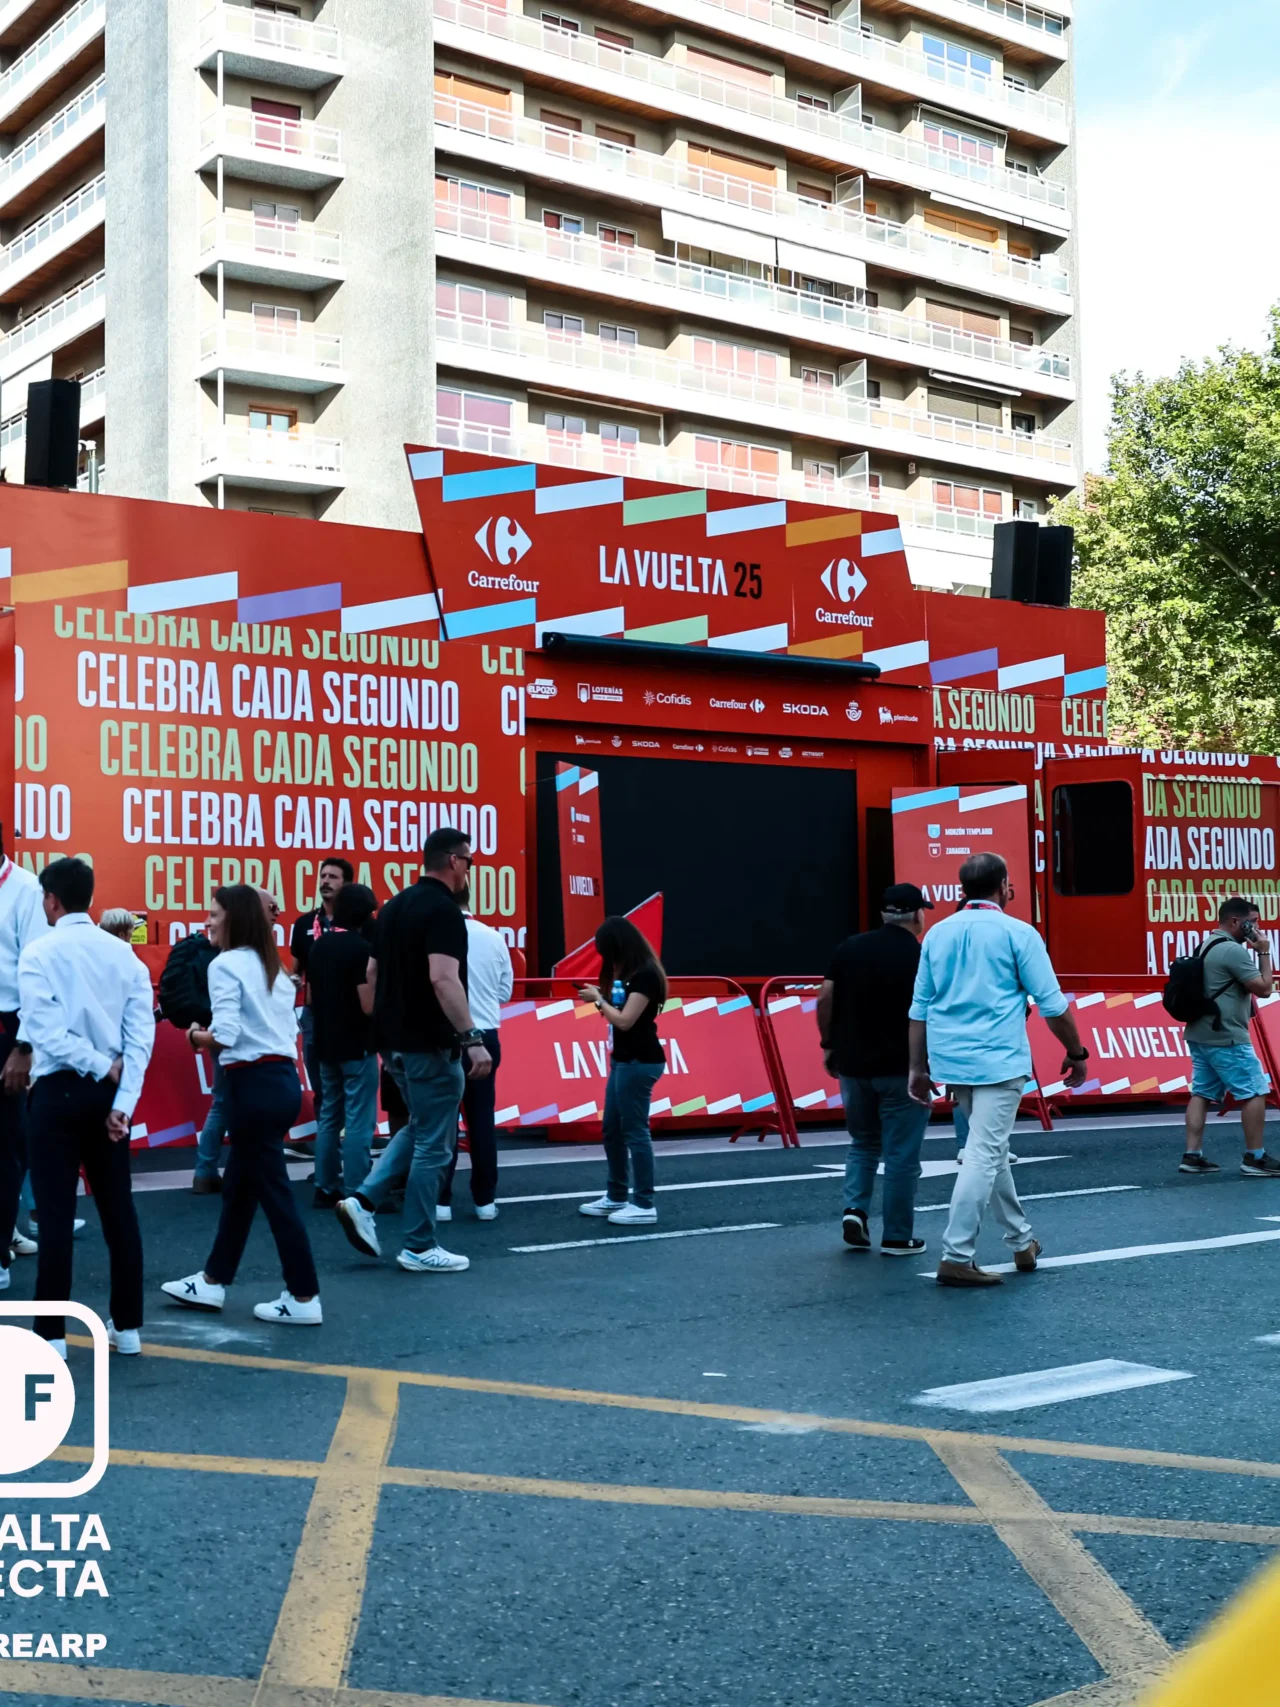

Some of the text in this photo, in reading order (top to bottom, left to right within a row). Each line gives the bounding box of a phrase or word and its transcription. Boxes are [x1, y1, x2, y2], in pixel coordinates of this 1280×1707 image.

[467, 570, 540, 593] Carrefour
[599, 545, 763, 600] LA VUELTA 25
[815, 608, 874, 627] Carrefour
[77, 650, 223, 716] CELEBRA
[232, 663, 314, 723] CADA
[322, 671, 460, 733] SEGUNDO
[592, 686, 623, 695] LOTERÍAS
[656, 693, 692, 706] Cofidis
[709, 698, 747, 710] Carrefour
[782, 703, 829, 716] SKODA
[893, 714, 919, 722] plenitude
[948, 689, 1036, 734] SEGUNDO
[100, 719, 244, 782] CELEBRA
[253, 729, 335, 787] CADA
[343, 735, 478, 794] SEGUNDO
[1172, 773, 1262, 819] SEGUNDO
[122, 787, 265, 847] CELEBRA
[274, 794, 355, 850] CADA
[1144, 825, 1276, 871] ADA SEGUNDO
[1146, 879, 1200, 922] CADA
[554, 1041, 592, 1080] LA
[1092, 1027, 1124, 1058] LA
